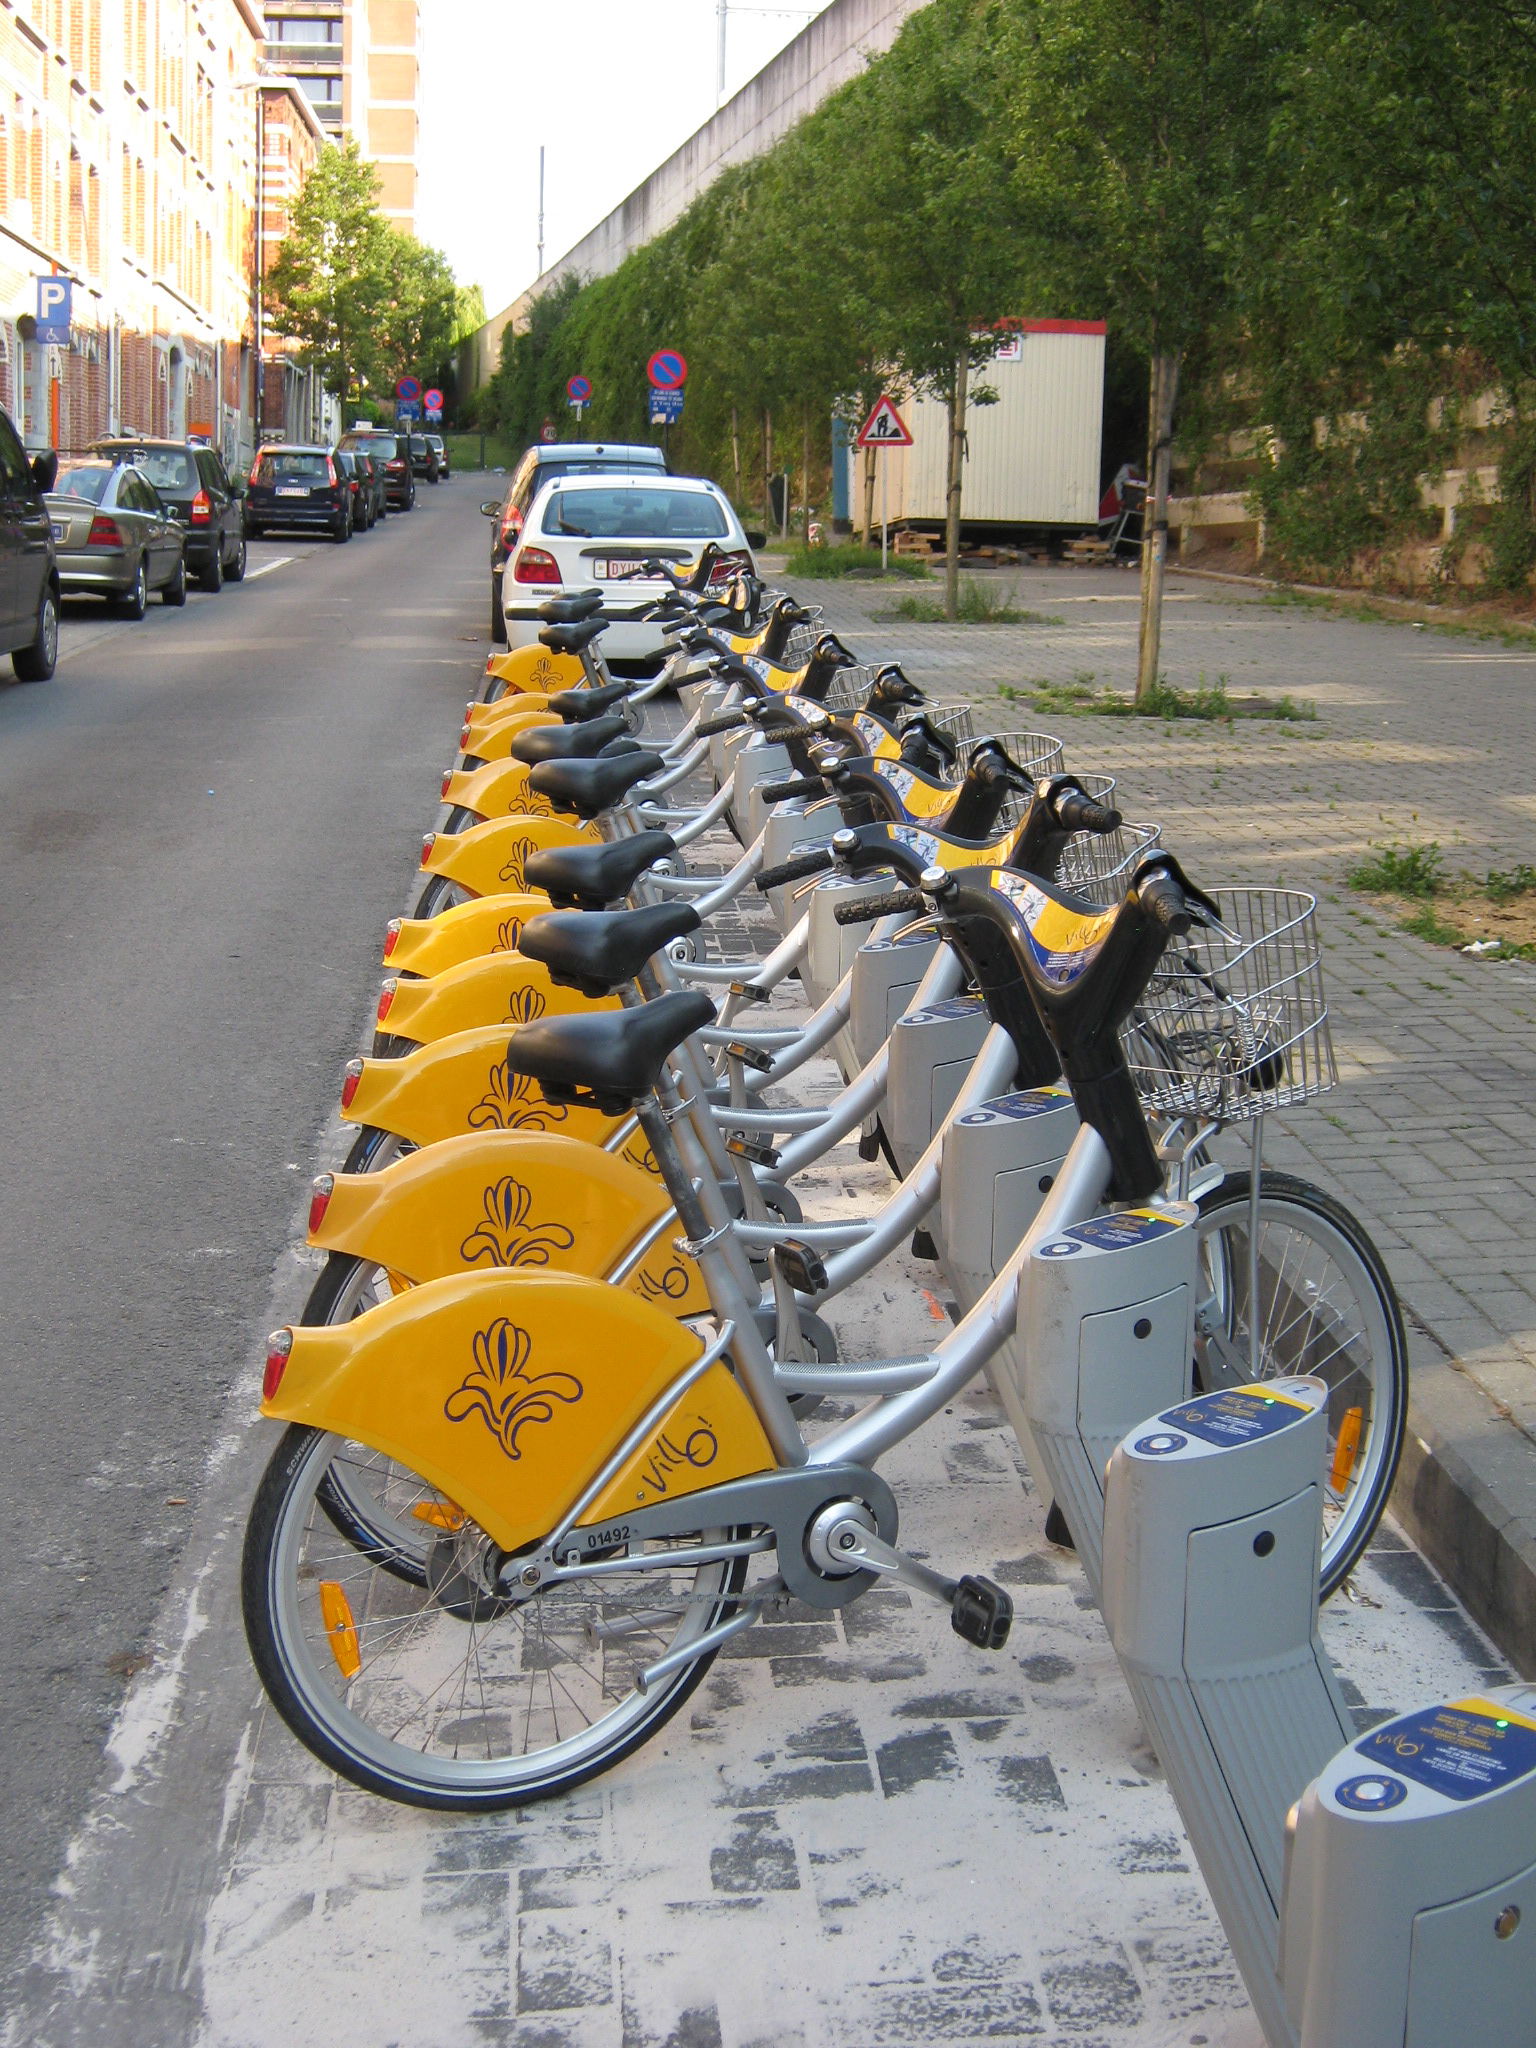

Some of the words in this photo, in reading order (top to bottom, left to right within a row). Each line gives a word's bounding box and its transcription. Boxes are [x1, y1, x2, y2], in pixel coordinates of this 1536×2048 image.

[41, 283, 65, 319] P
[1292, 1386, 1310, 1394] 2
[587, 1526, 631, 1548] 01492
